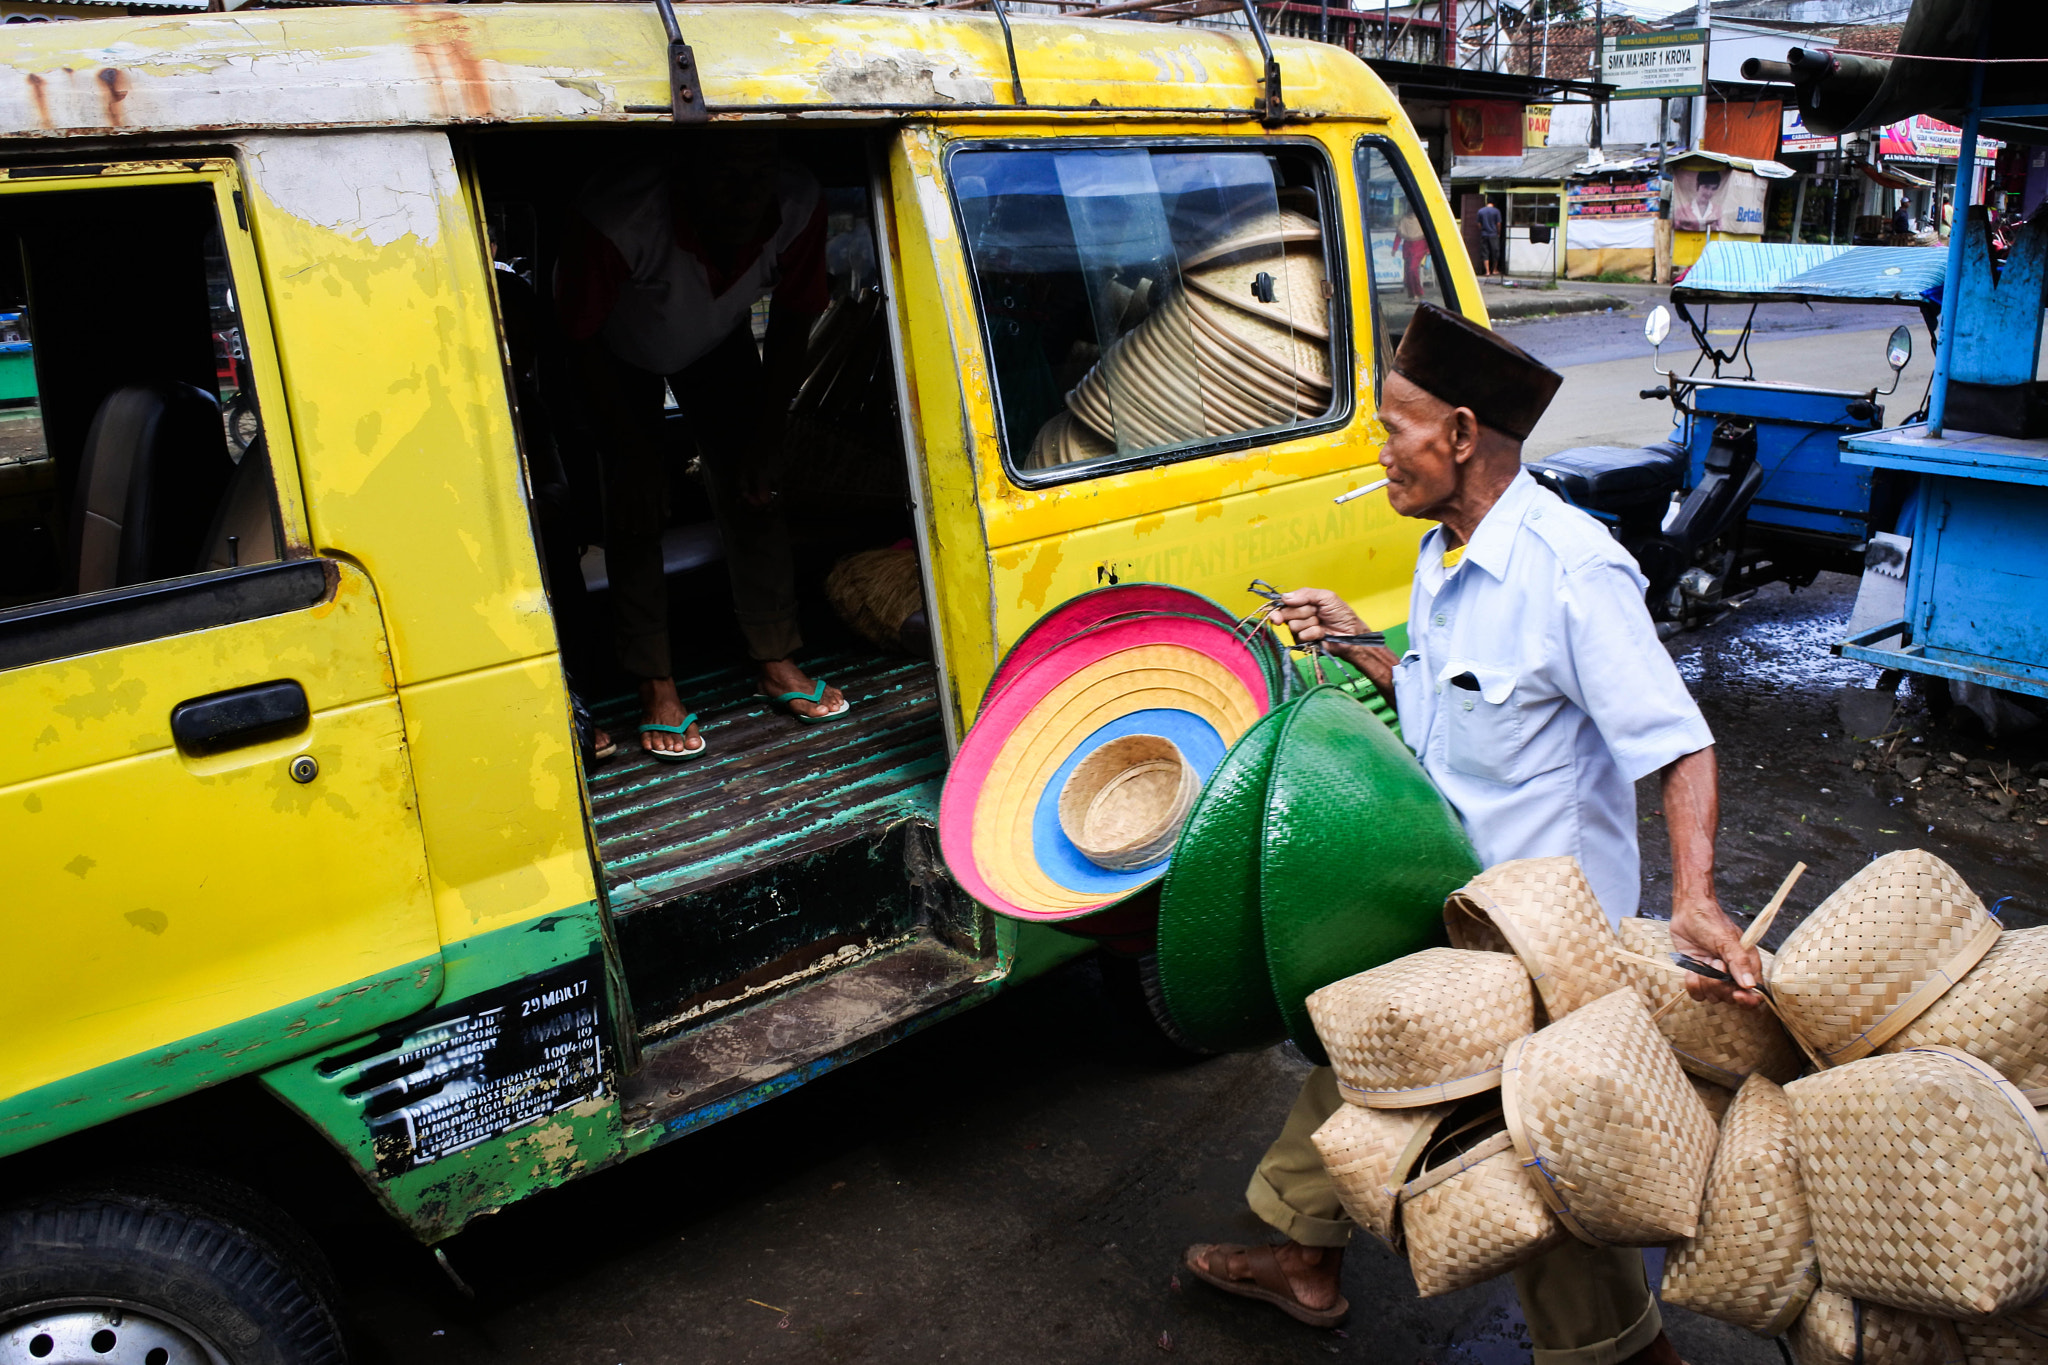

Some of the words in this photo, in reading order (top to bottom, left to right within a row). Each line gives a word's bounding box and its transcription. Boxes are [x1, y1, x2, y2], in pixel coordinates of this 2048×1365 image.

[1608, 54, 1624, 69] SMK
[1626, 52, 1657, 68] MA'ARIF
[1659, 50, 1663, 65] 1
[1665, 49, 1691, 65] KROYA
[542, 988, 573, 1009] MAR
[573, 980, 588, 996] 17
